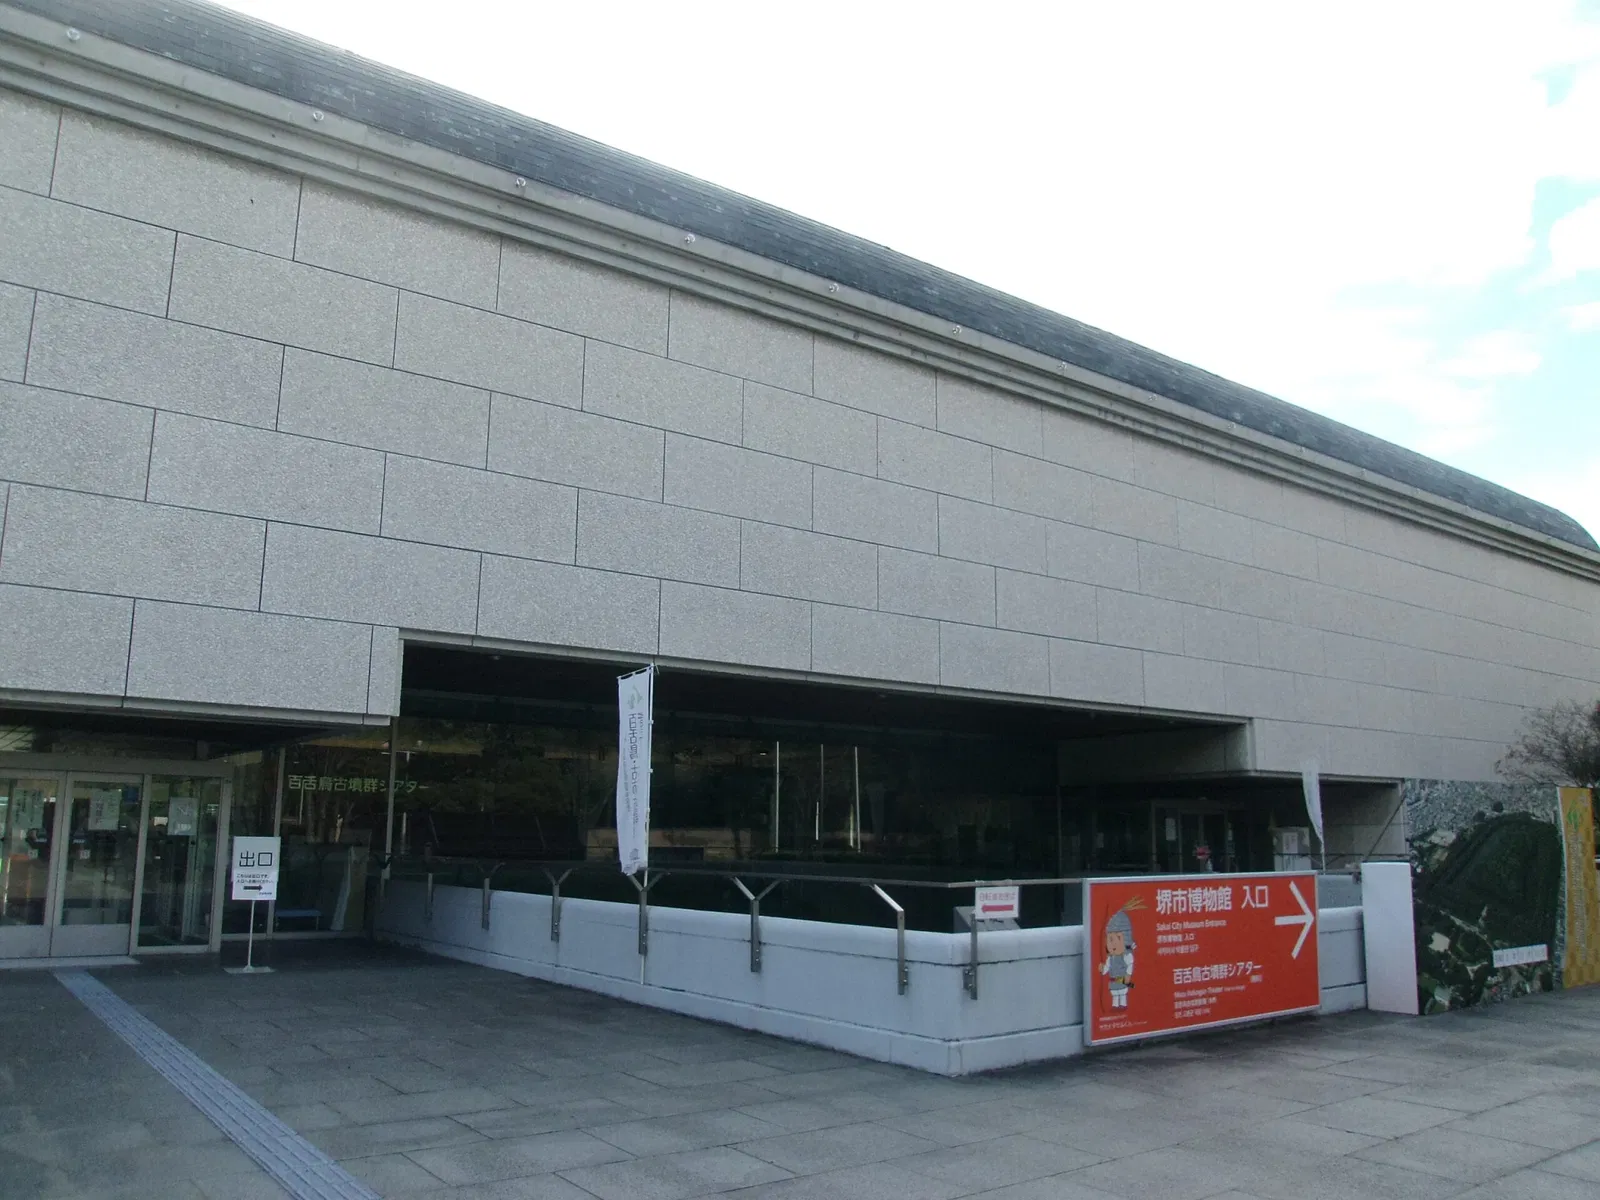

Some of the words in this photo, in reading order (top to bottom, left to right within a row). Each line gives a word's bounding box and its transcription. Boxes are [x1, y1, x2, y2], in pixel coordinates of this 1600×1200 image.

[239, 851, 273, 867] 出口
[1156, 887, 1232, 914] 堺市博物館
[1241, 885, 1269, 909] 入口
[1171, 922, 1182, 932] City
[1183, 920, 1204, 929] Museum
[1173, 961, 1262, 985] 百舌鳥古墳群シアター
